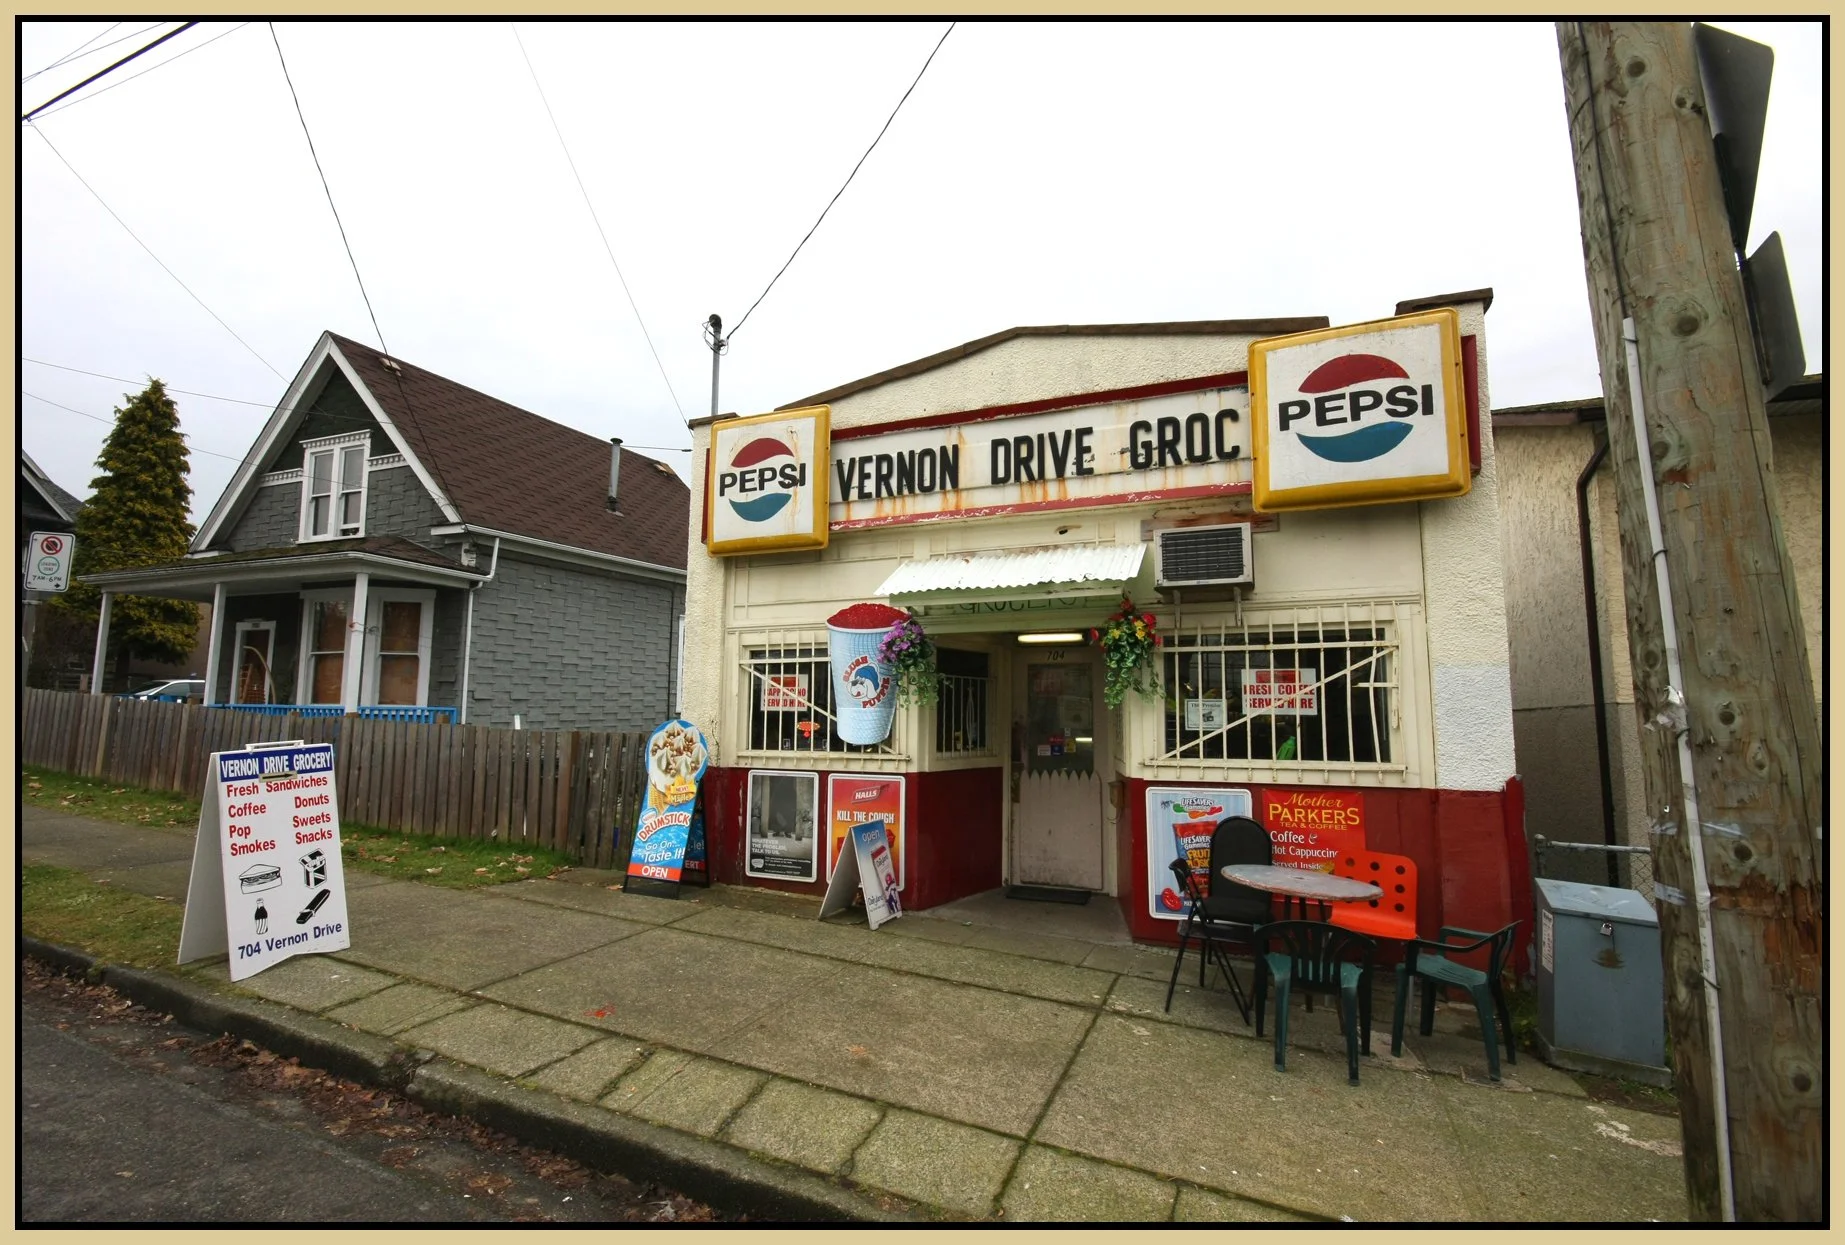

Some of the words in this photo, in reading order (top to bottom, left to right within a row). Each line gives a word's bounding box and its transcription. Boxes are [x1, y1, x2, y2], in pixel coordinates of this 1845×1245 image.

[1278, 384, 1434, 432] PEPSI
[836, 444, 960, 502] VERNON
[990, 427, 1095, 486] DRIVE
[1129, 408, 1240, 470] GROC
[719, 463, 806, 497] PEPSI
[1046, 650, 1065, 661] 704
[842, 655, 869, 682] SLUSH
[789, 699, 806, 708] HRE
[1288, 698, 1314, 709] HRE
[221, 758, 259, 778] VERNON
[263, 755, 289, 773] DRIVE
[293, 751, 331, 771] GROCERY
[226, 782, 259, 798] Fresh
[266, 775, 328, 793] Sandwiches
[294, 794, 330, 809] Donuts
[855, 789, 877, 800] HALLS
[1283, 792, 1344, 808] Mother
[228, 802, 267, 818] Coffee
[836, 810, 851, 821] KILL
[853, 811, 867, 822] THE
[868, 812, 895, 824] COUGH
[1268, 803, 1360, 825] PARKERS
[292, 812, 331, 828] Sweets
[637, 812, 691, 842] DRUMSTICK
[1308, 823, 1348, 831] COFFEE
[229, 825, 251, 839] Pop
[295, 828, 333, 845] Snacks
[861, 829, 880, 844] open
[1270, 830, 1305, 844] Coffee
[645, 842, 657, 851] Go
[1180, 835, 1211, 845] LIFESAVER
[230, 839, 276, 857] Smokes
[643, 850, 672, 863] Taste
[674, 847, 685, 859] It!
[1271, 845, 1286, 855] Hot
[641, 865, 668, 879] OPEN
[684, 860, 699, 869] ERT
[1271, 860, 1298, 868] Served
[1300, 862, 1322, 870] Inside
[238, 941, 262, 959] 704
[265, 932, 308, 952] Vernon
[313, 923, 342, 939] Drive
